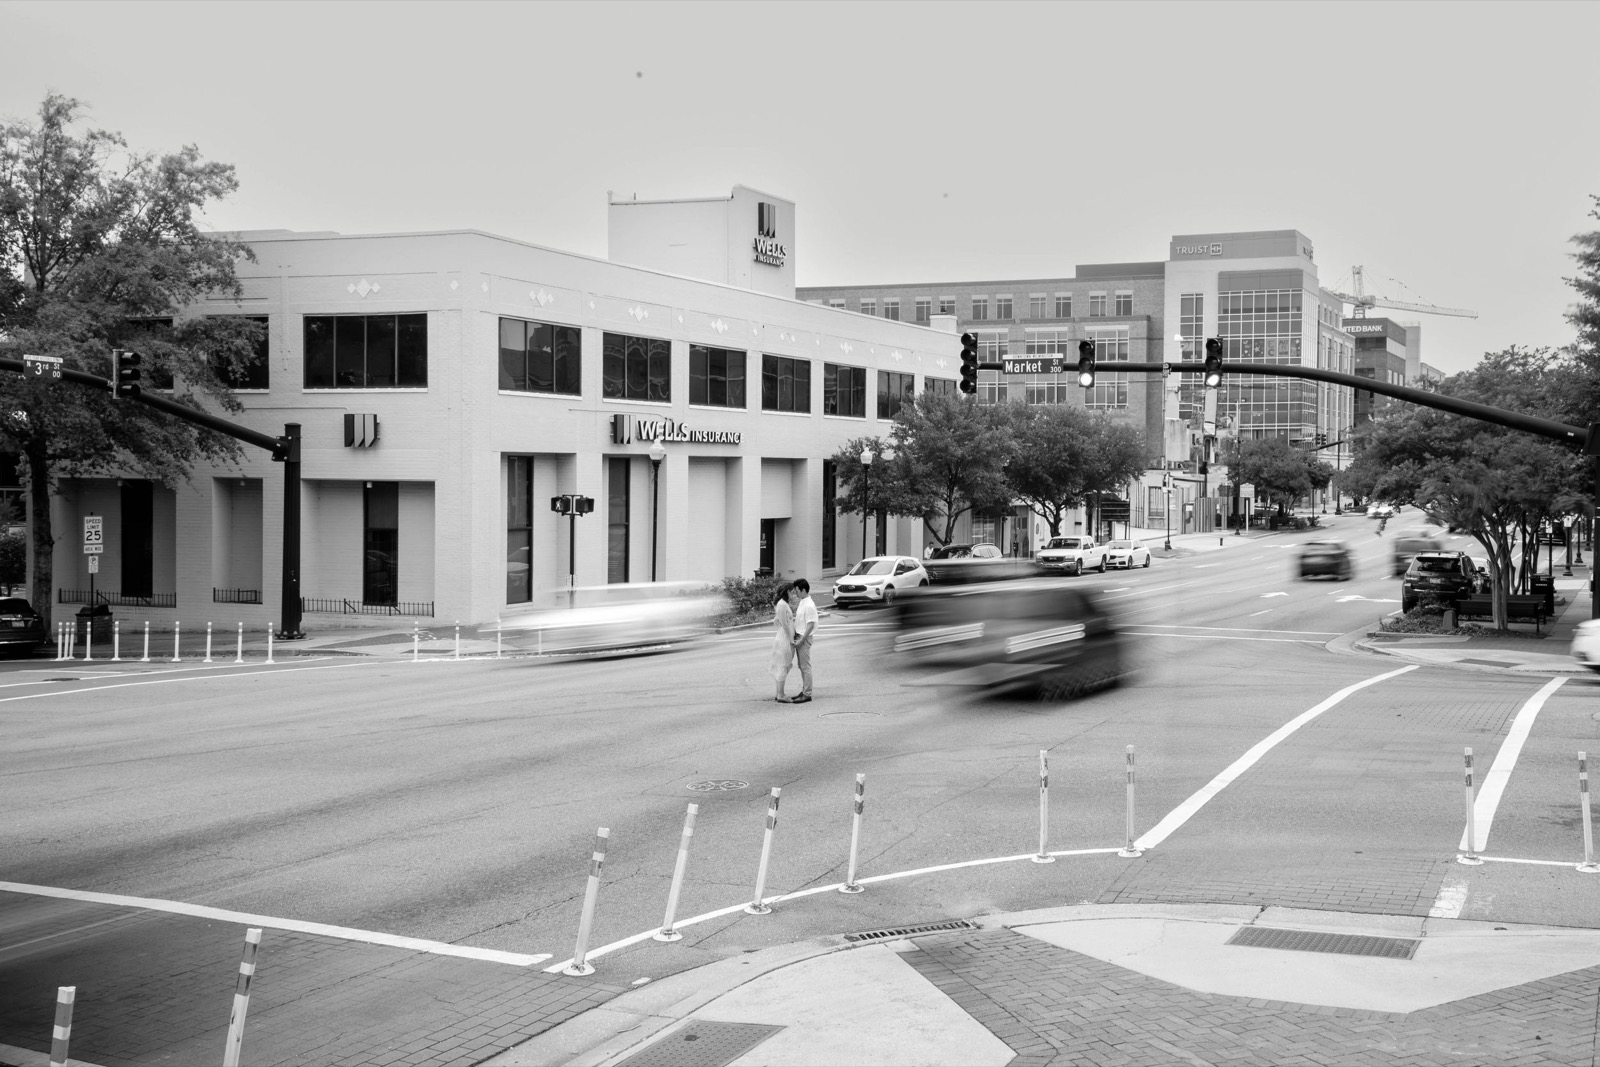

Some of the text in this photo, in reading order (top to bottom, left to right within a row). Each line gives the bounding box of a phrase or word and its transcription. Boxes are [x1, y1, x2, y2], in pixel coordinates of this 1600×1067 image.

[754, 238, 787, 258] WELLS
[1176, 246, 1208, 254] TRUIST
[35, 362, 49, 375] 3rd
[53, 362, 60, 370] St
[1005, 360, 1042, 373] Market
[52, 370, 61, 378] 00
[638, 420, 744, 443] WELLS INSURANCE
[86, 530, 101, 541] 25
